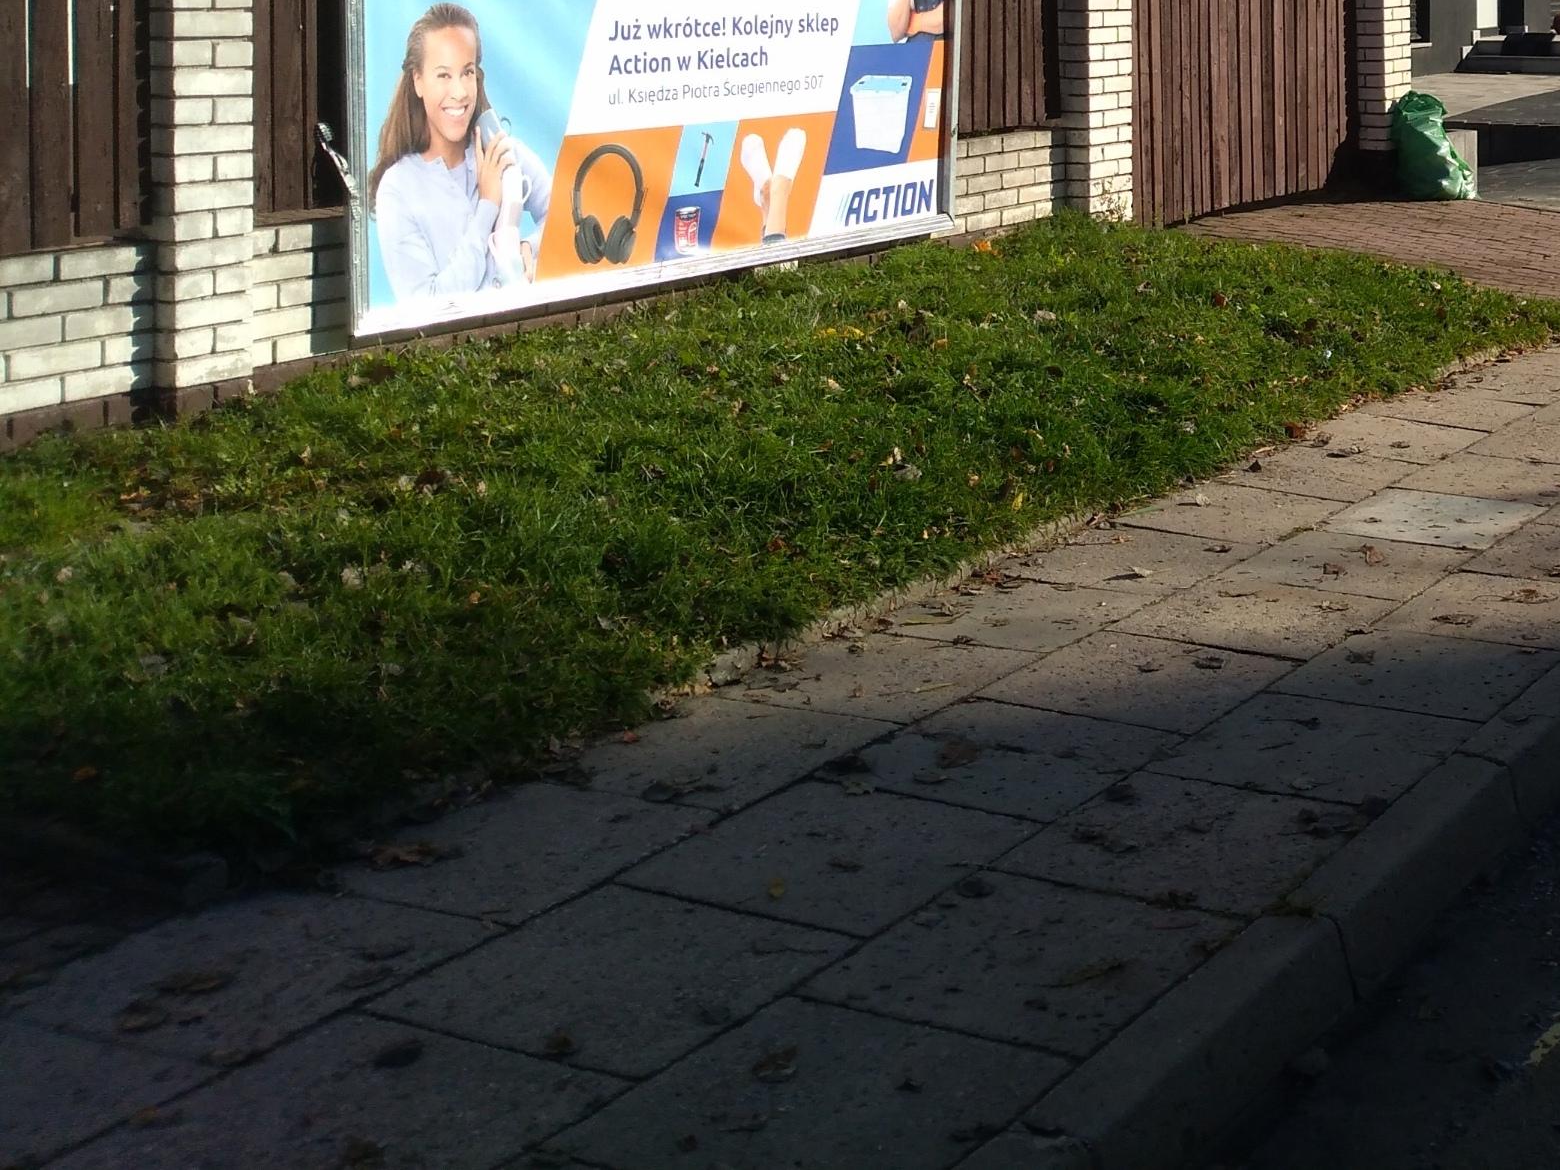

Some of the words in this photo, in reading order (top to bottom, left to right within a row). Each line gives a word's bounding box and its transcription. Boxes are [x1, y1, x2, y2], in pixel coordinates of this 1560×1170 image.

[608, 18, 642, 41] Już
[647, 16, 726, 39] wkrótce!
[732, 14, 794, 39] Kolejny
[798, 12, 839, 36] sklep
[608, 51, 671, 76] Action
[677, 56, 692, 71] w
[697, 45, 769, 70] Kielcach
[608, 87, 624, 105] ul.
[628, 85, 679, 105] Księdza
[682, 84, 720, 99] Piotra
[723, 77, 801, 98] Ściegiennego
[804, 74, 824, 90] 507
[844, 179, 935, 227] ACTION
